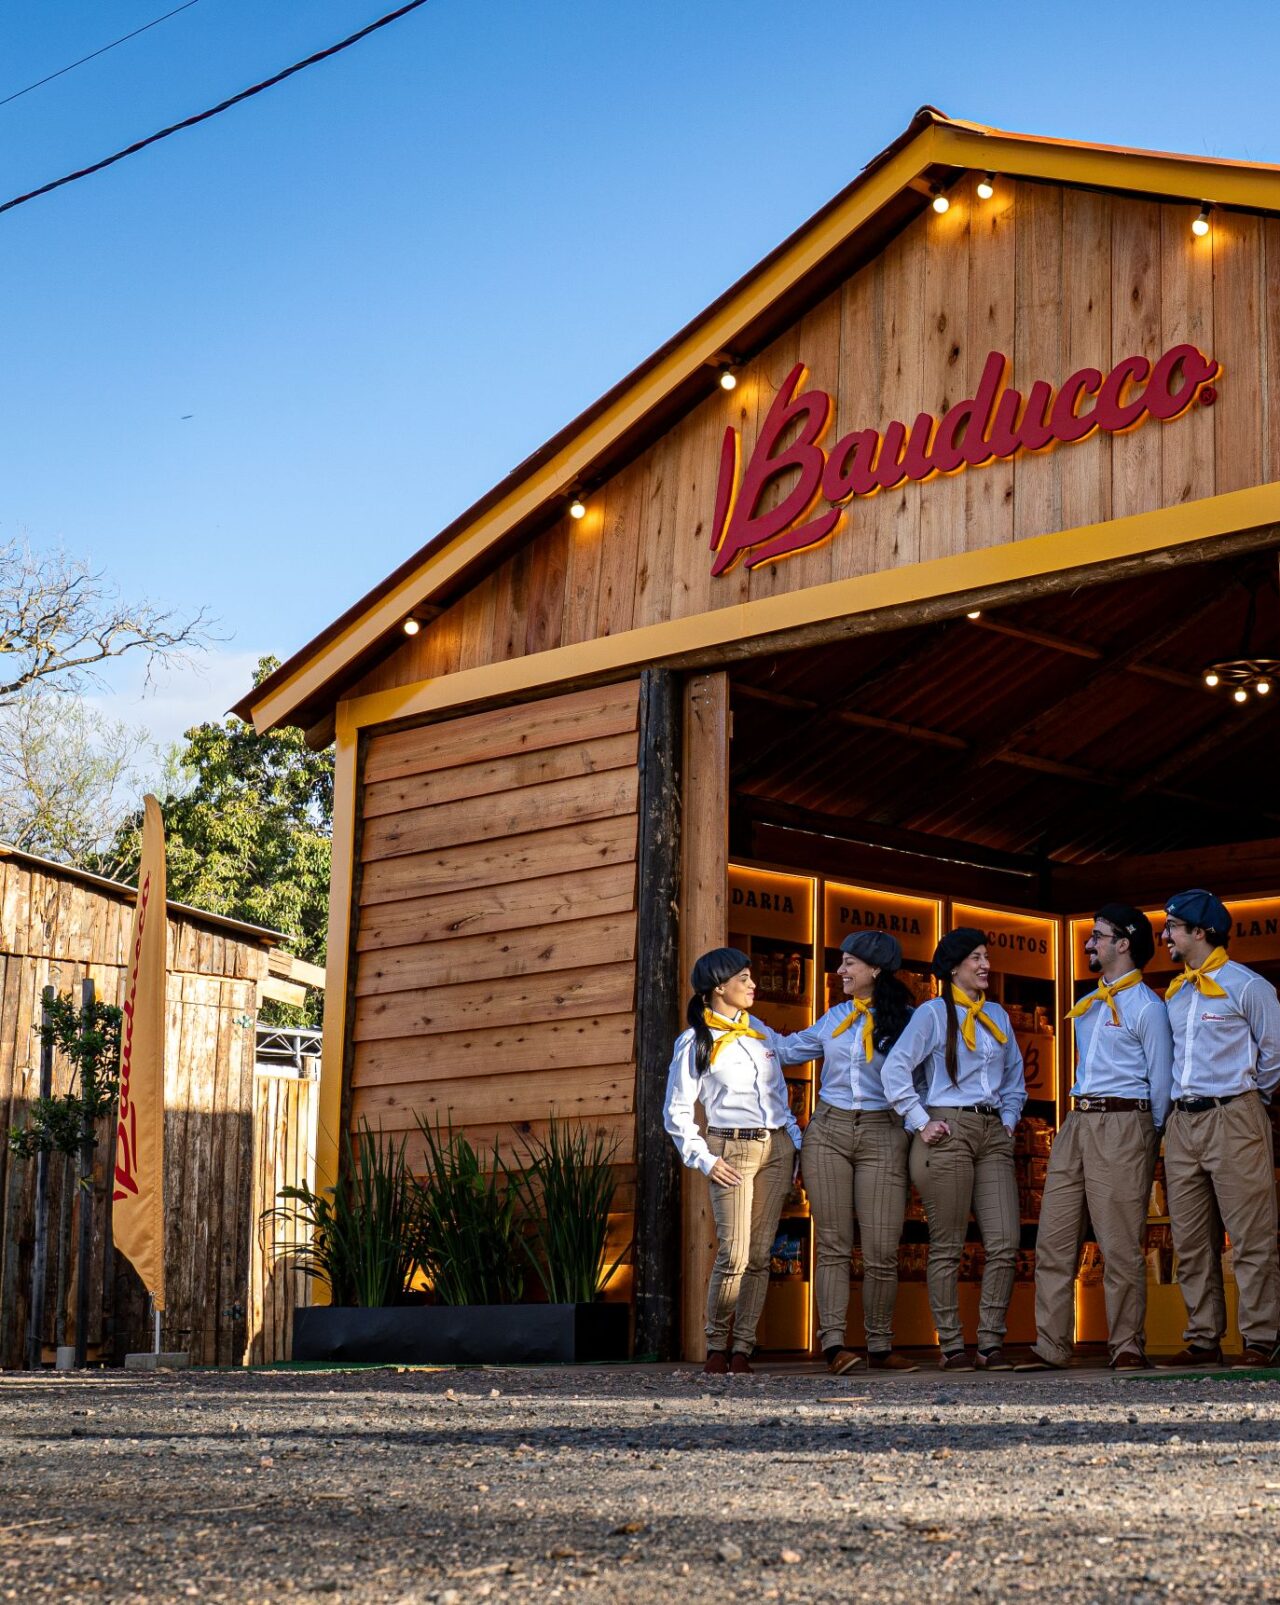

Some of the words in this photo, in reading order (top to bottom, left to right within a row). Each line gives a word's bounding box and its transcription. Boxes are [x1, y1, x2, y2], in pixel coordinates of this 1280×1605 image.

[732, 887, 794, 914] DARIA
[839, 907, 921, 935] PADARIA
[987, 930, 1047, 954] COITOS
